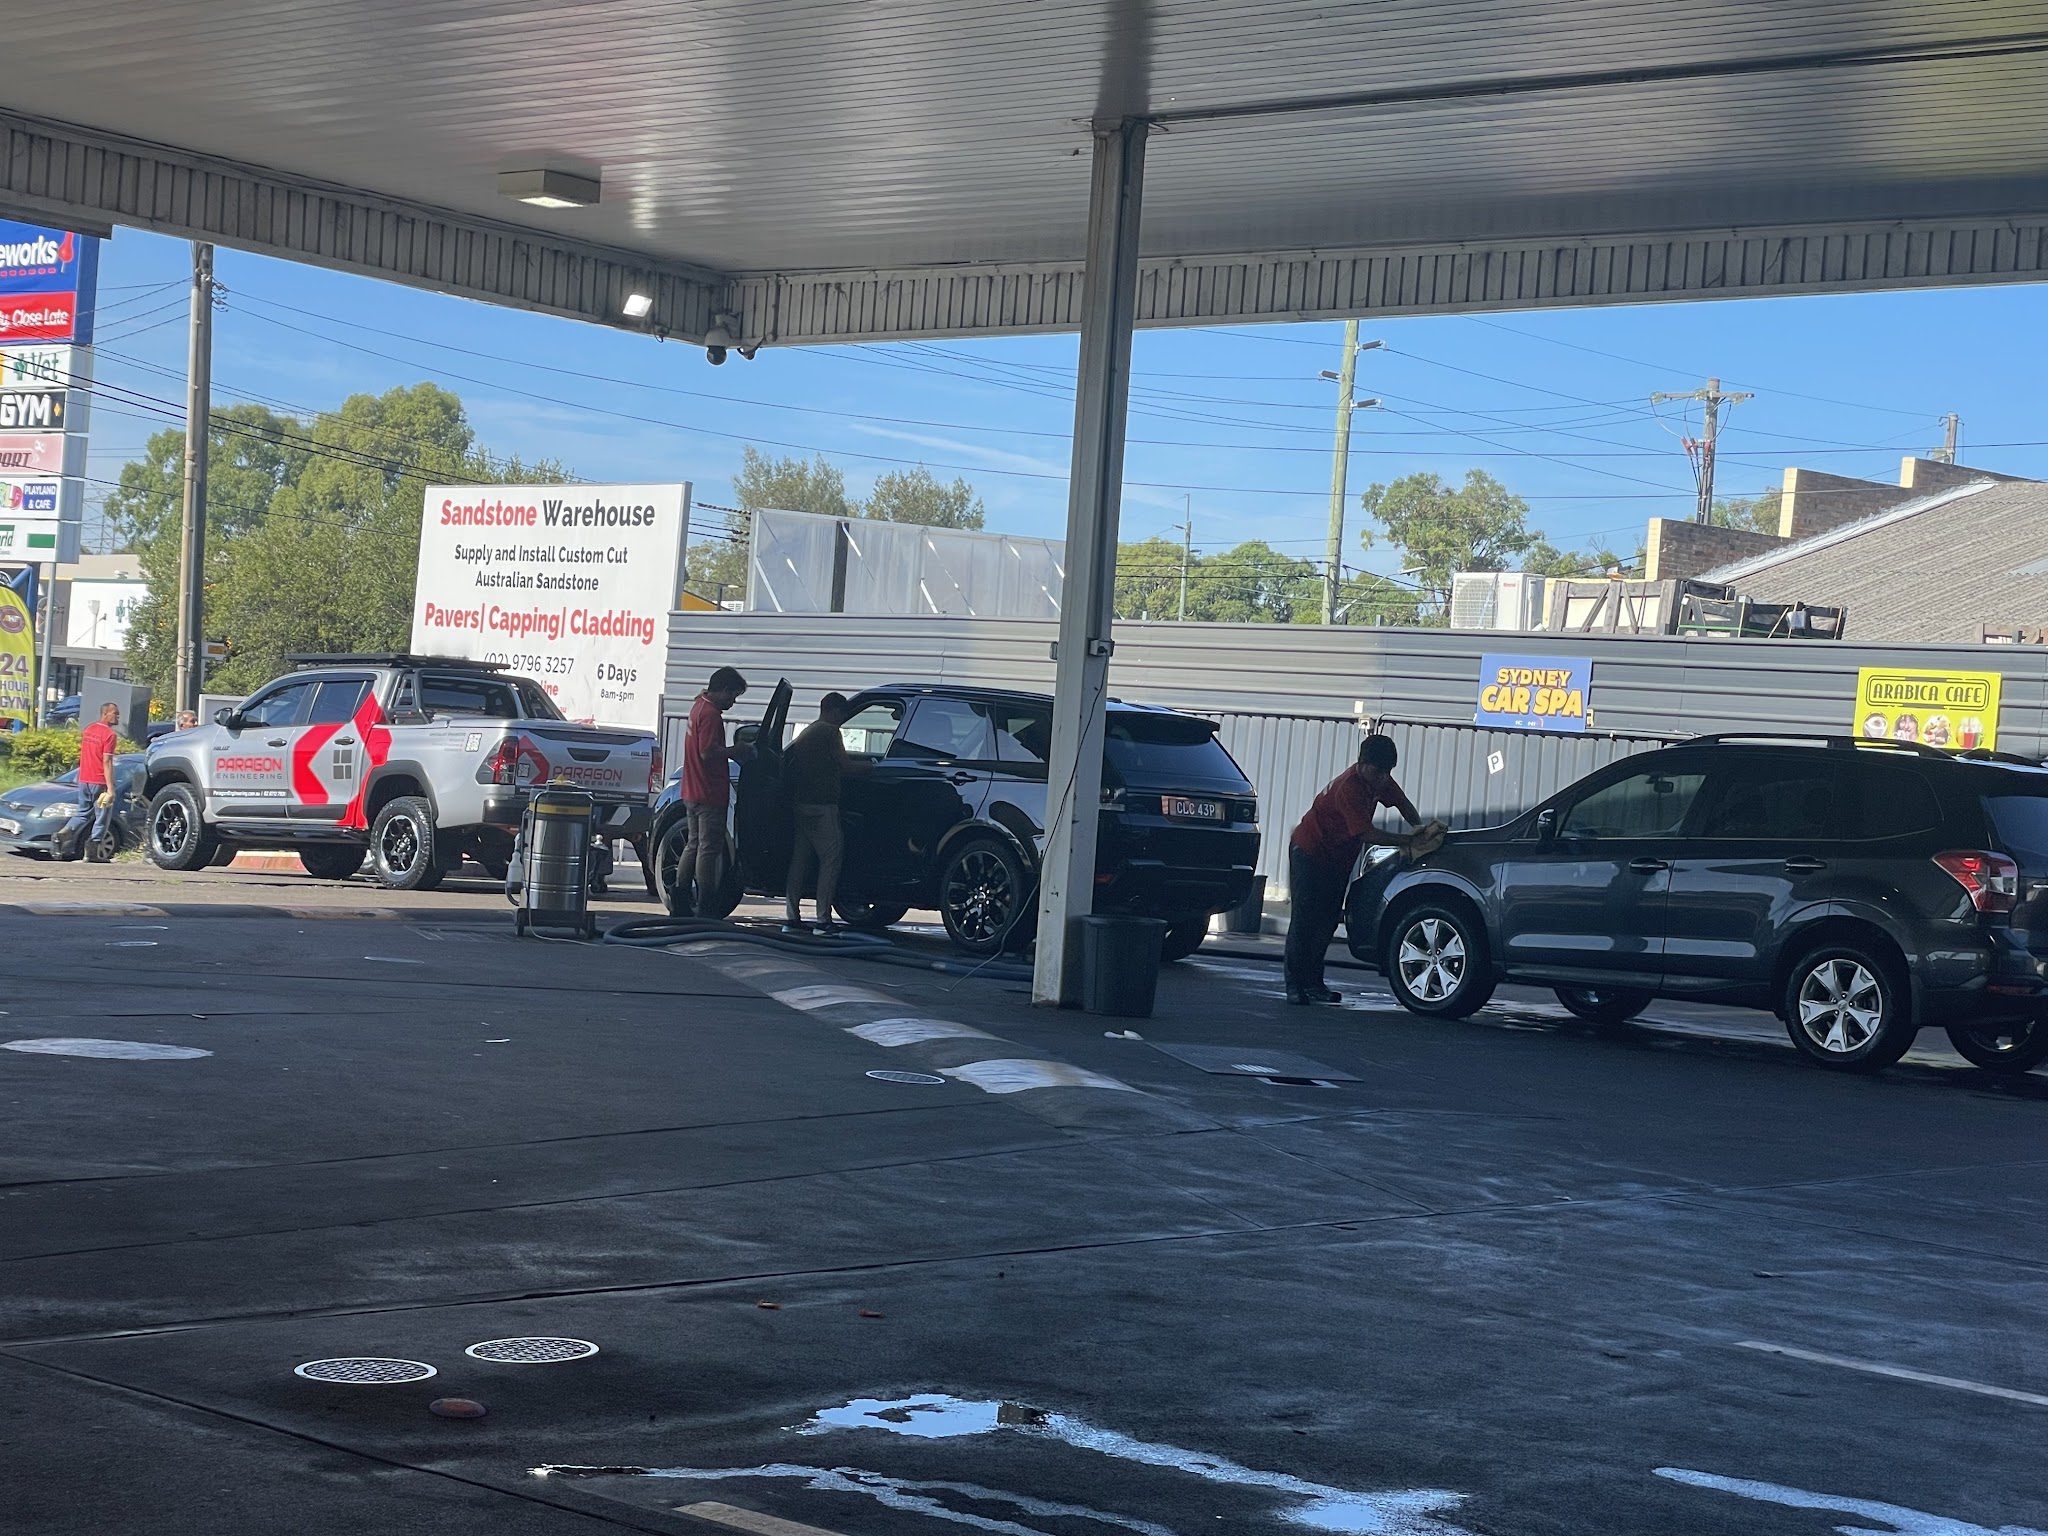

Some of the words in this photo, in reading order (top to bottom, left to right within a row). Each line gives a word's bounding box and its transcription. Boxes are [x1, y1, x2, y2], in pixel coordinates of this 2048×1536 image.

[12, 309, 42, 327] Close
[44, 308, 69, 326] Late
[32, 352, 59, 380] Vet
[0, 394, 51, 427] GYM
[24, 485, 56, 495] PLAYLAND
[35, 499, 52, 509] CAFE
[440, 499, 537, 527] Sandstone
[543, 499, 656, 527] Warehouse
[454, 544, 492, 565] Supply
[495, 545, 516, 562] and
[519, 545, 556, 562] Install
[558, 547, 604, 564] Custom
[606, 547, 628, 564] Cut
[475, 571, 533, 589] Australian
[536, 573, 599, 591] Sandstone
[570, 610, 655, 645] Cladding
[0, 652, 28, 677] 24
[512, 654, 541, 671] 9796
[545, 656, 575, 674] 3257
[597, 664, 604, 680] 6
[607, 664, 637, 686] Days
[1497, 668, 1572, 688] SYDNEY
[0, 680, 29, 692] HOUR
[600, 688, 635, 701] 8am-5pm
[1873, 683, 1939, 701] ARABICA
[1946, 686, 1982, 703] CAFE
[0, 695, 29, 709] GYM
[1480, 685, 1531, 715] CAR
[1533, 687, 1584, 718] SPA
[216, 757, 283, 772] PARAGON
[1491, 755, 1499, 770] P
[552, 766, 623, 781] PARAGON
[1176, 801, 1195, 815] CLC
[1197, 803, 1215, 816] 43P
